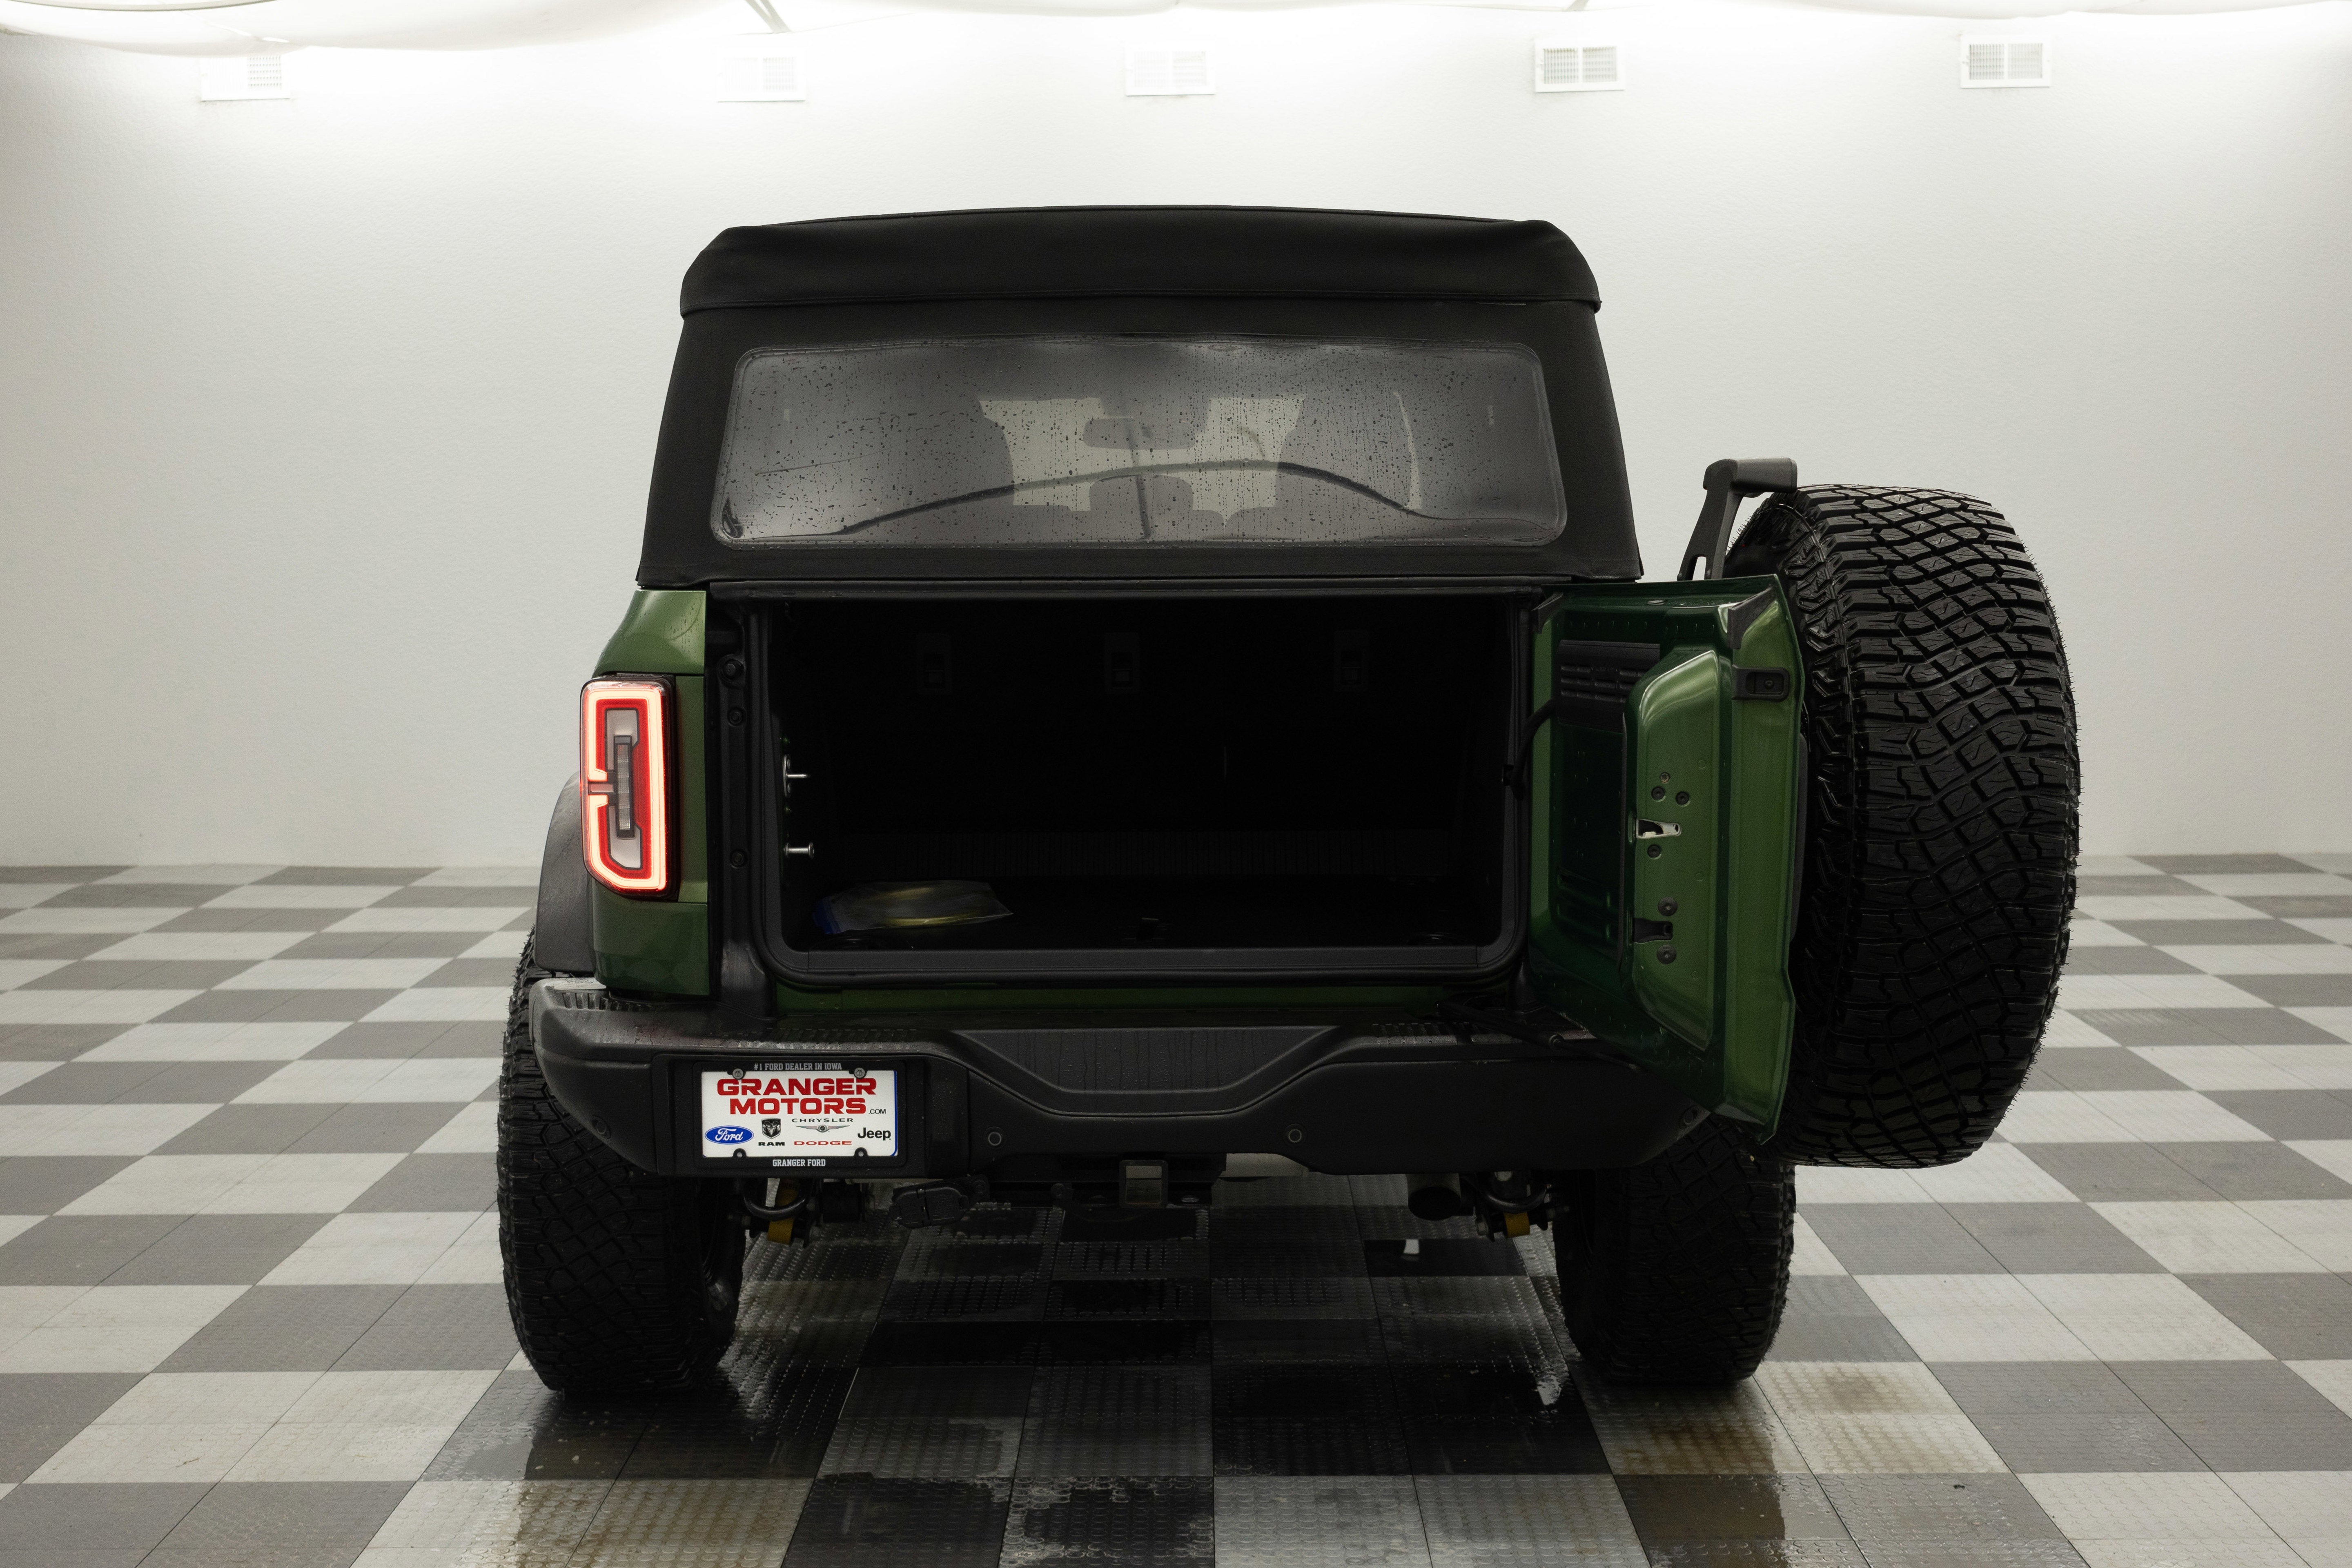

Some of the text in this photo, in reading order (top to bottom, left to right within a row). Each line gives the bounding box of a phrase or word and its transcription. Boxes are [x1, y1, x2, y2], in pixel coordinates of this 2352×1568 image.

[717, 1078, 877, 1096] GRANGER
[730, 1098, 866, 1115] MOTORS
[715, 1128, 744, 1141] Ford
[857, 1127, 891, 1141] Jeep
[772, 1158, 826, 1167] GRANGER FORD
